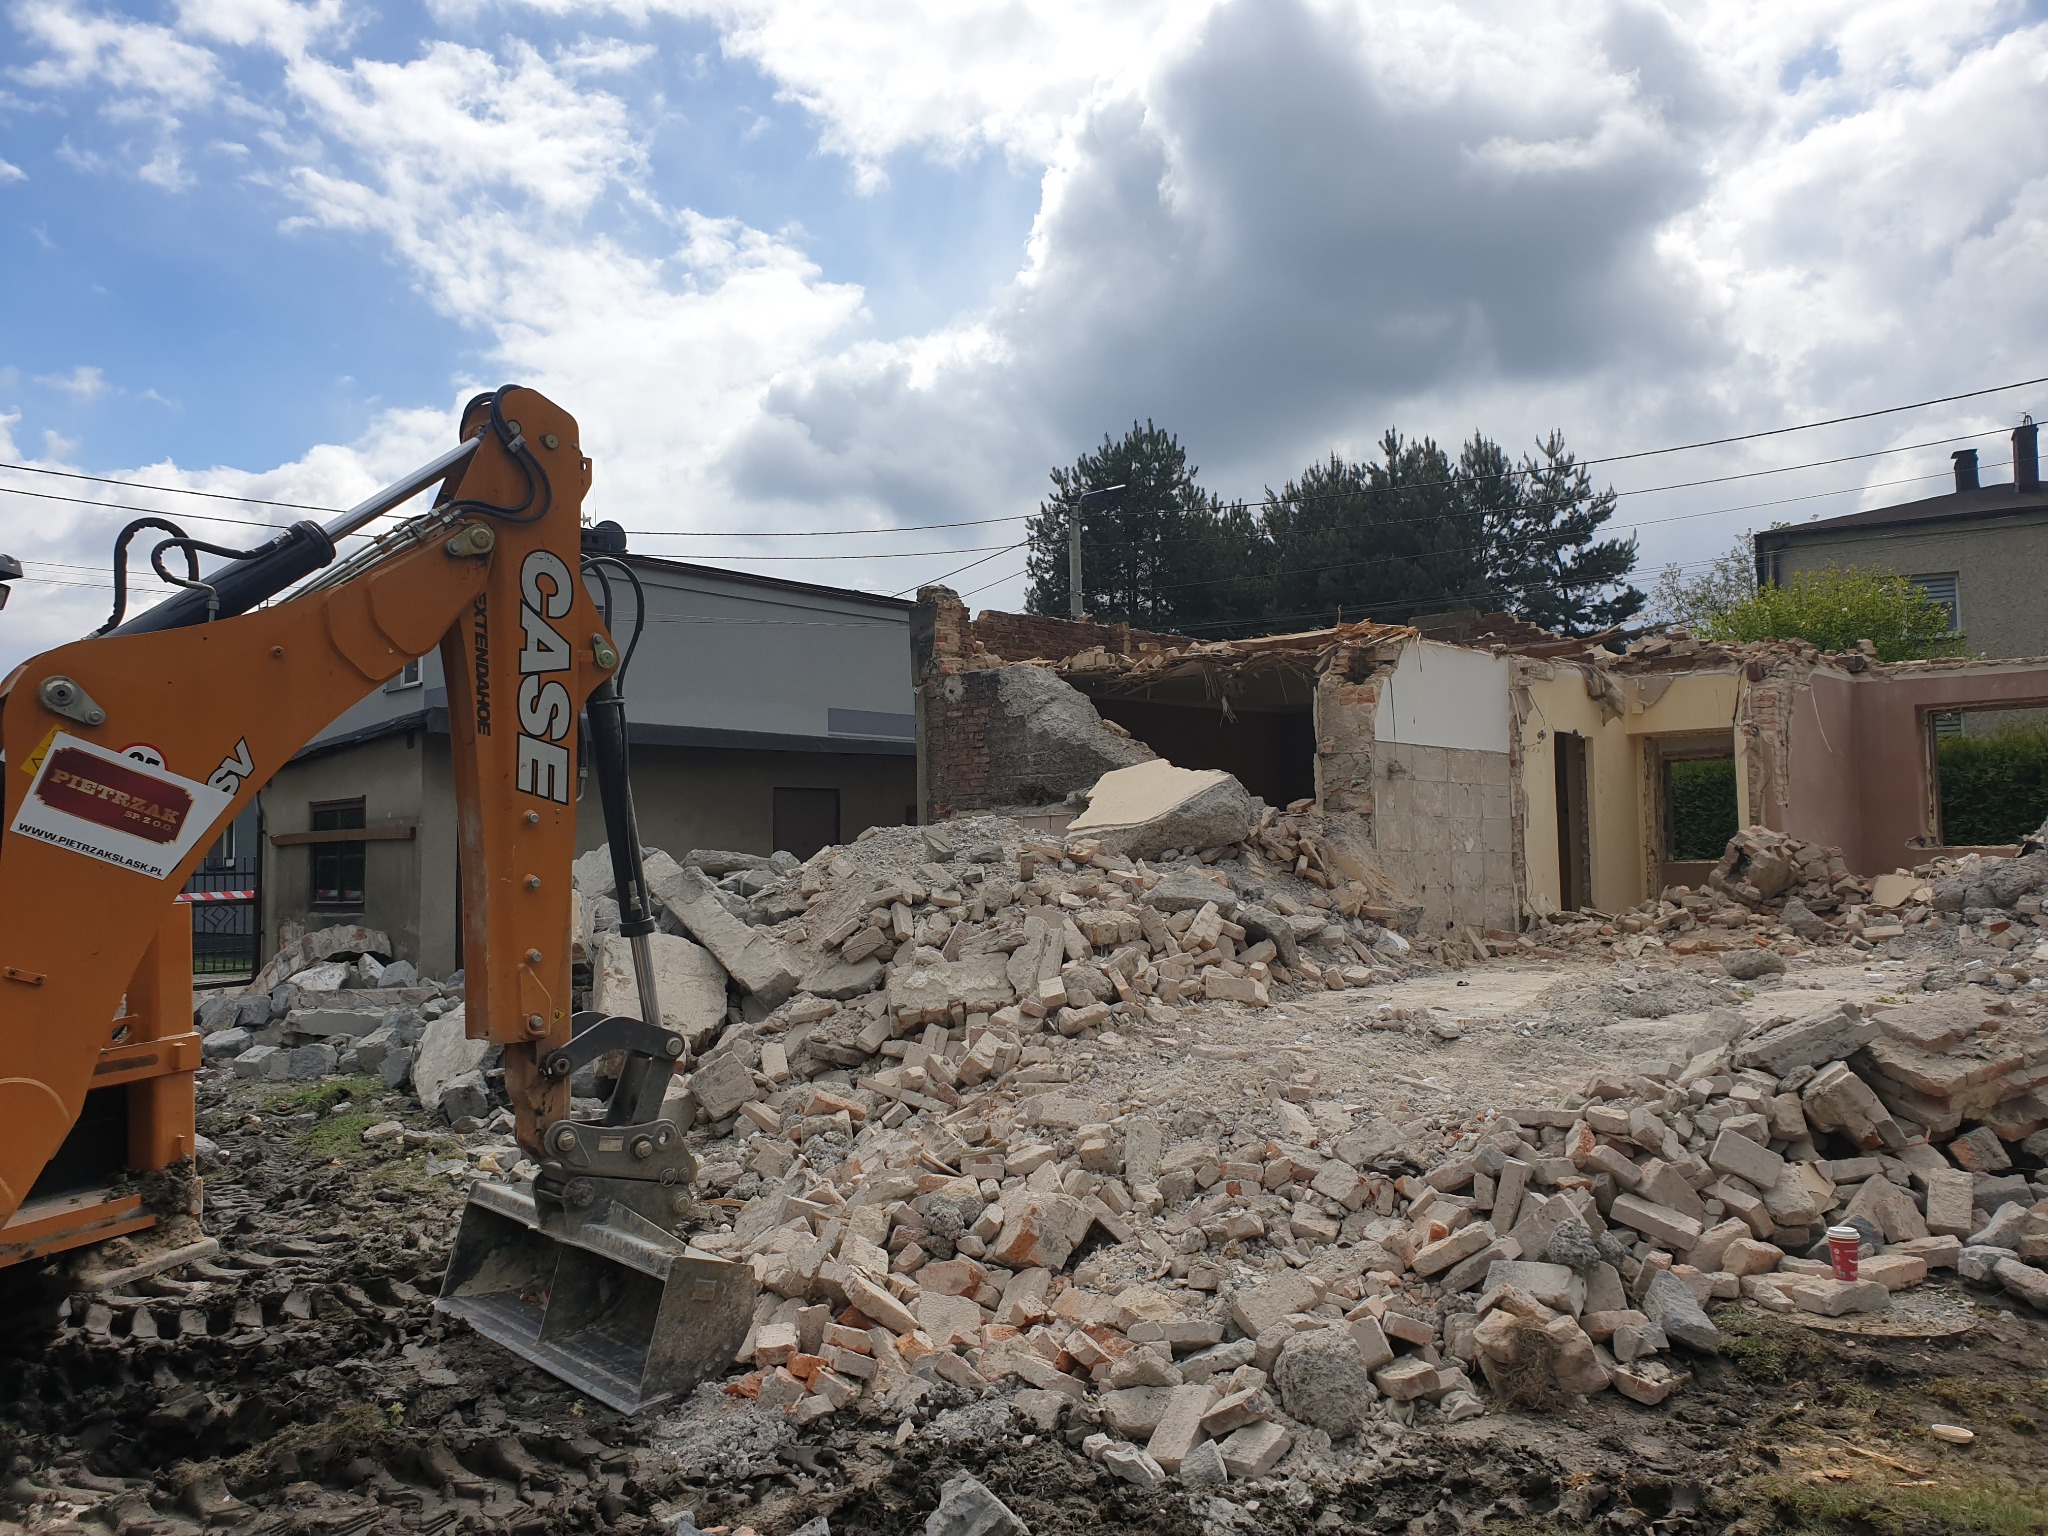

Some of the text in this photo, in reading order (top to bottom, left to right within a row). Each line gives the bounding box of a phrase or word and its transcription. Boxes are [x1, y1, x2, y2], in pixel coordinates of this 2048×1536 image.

[473, 591, 491, 737] EXTENDAHOE
[516, 550, 574, 805] CASE
[50, 768, 180, 825] PIETRZAK
[124, 810, 141, 821] SP.
[18, 822, 163, 877] WWW.PIETRZAKSLASK.PL
